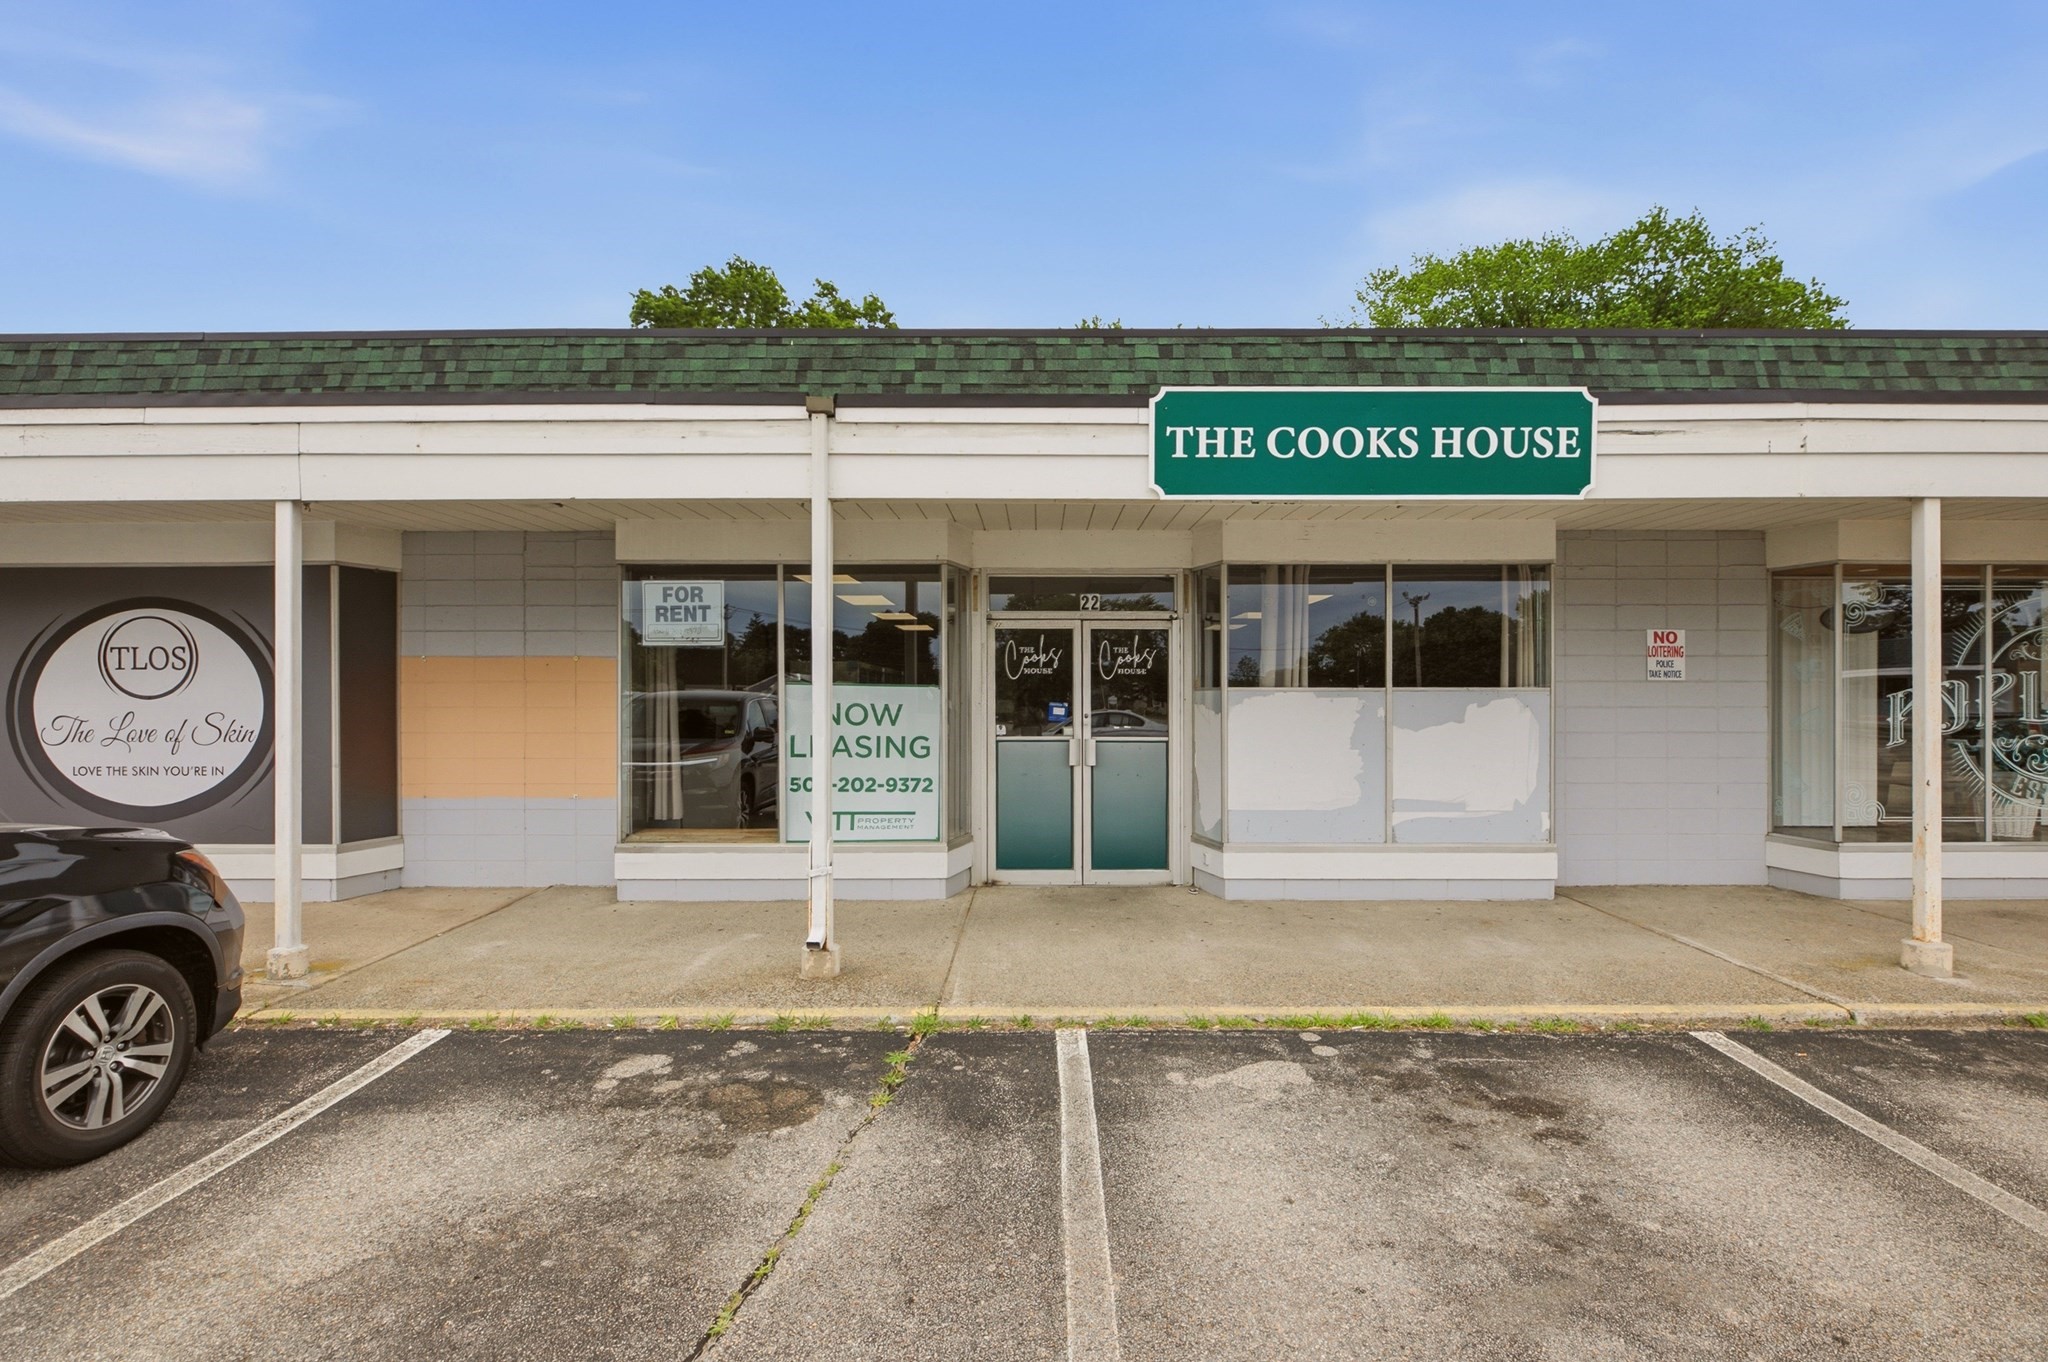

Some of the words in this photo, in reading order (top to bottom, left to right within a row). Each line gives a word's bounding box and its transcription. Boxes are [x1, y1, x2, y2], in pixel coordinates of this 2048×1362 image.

[1165, 426, 1256, 459] THE
[1266, 426, 1419, 459] COOKS
[1431, 426, 1582, 459] HOUSE
[662, 586, 704, 603] FOR
[1081, 595, 1099, 610] 22
[655, 605, 711, 622] RENT
[1653, 631, 1678, 644] NO
[110, 646, 187, 670] TLOS
[1005, 634, 1063, 680] Cooks
[1019, 646, 1035, 654] THE
[1099, 634, 1157, 680] Cooks
[1113, 646, 1129, 654] THE
[1647, 645, 1684, 658] LOITERING
[1023, 667, 1053, 675] HOUSE
[1656, 660, 1674, 668] POLICE
[1648, 670, 1662, 678] TAKE
[1663, 670, 1682, 679] NOTICE
[40, 715, 95, 747] The
[100, 711, 158, 754] Love
[164, 719, 189, 756] of
[191, 711, 256, 747] Skin
[789, 735, 931, 759] LASING
[72, 766, 102, 777] LOVE
[106, 766, 128, 777] THE
[132, 766, 159, 777] SKIN
[163, 766, 207, 777] YOU'RE
[211, 766, 225, 777] IN
[789, 776, 934, 793] 50-202-9372
